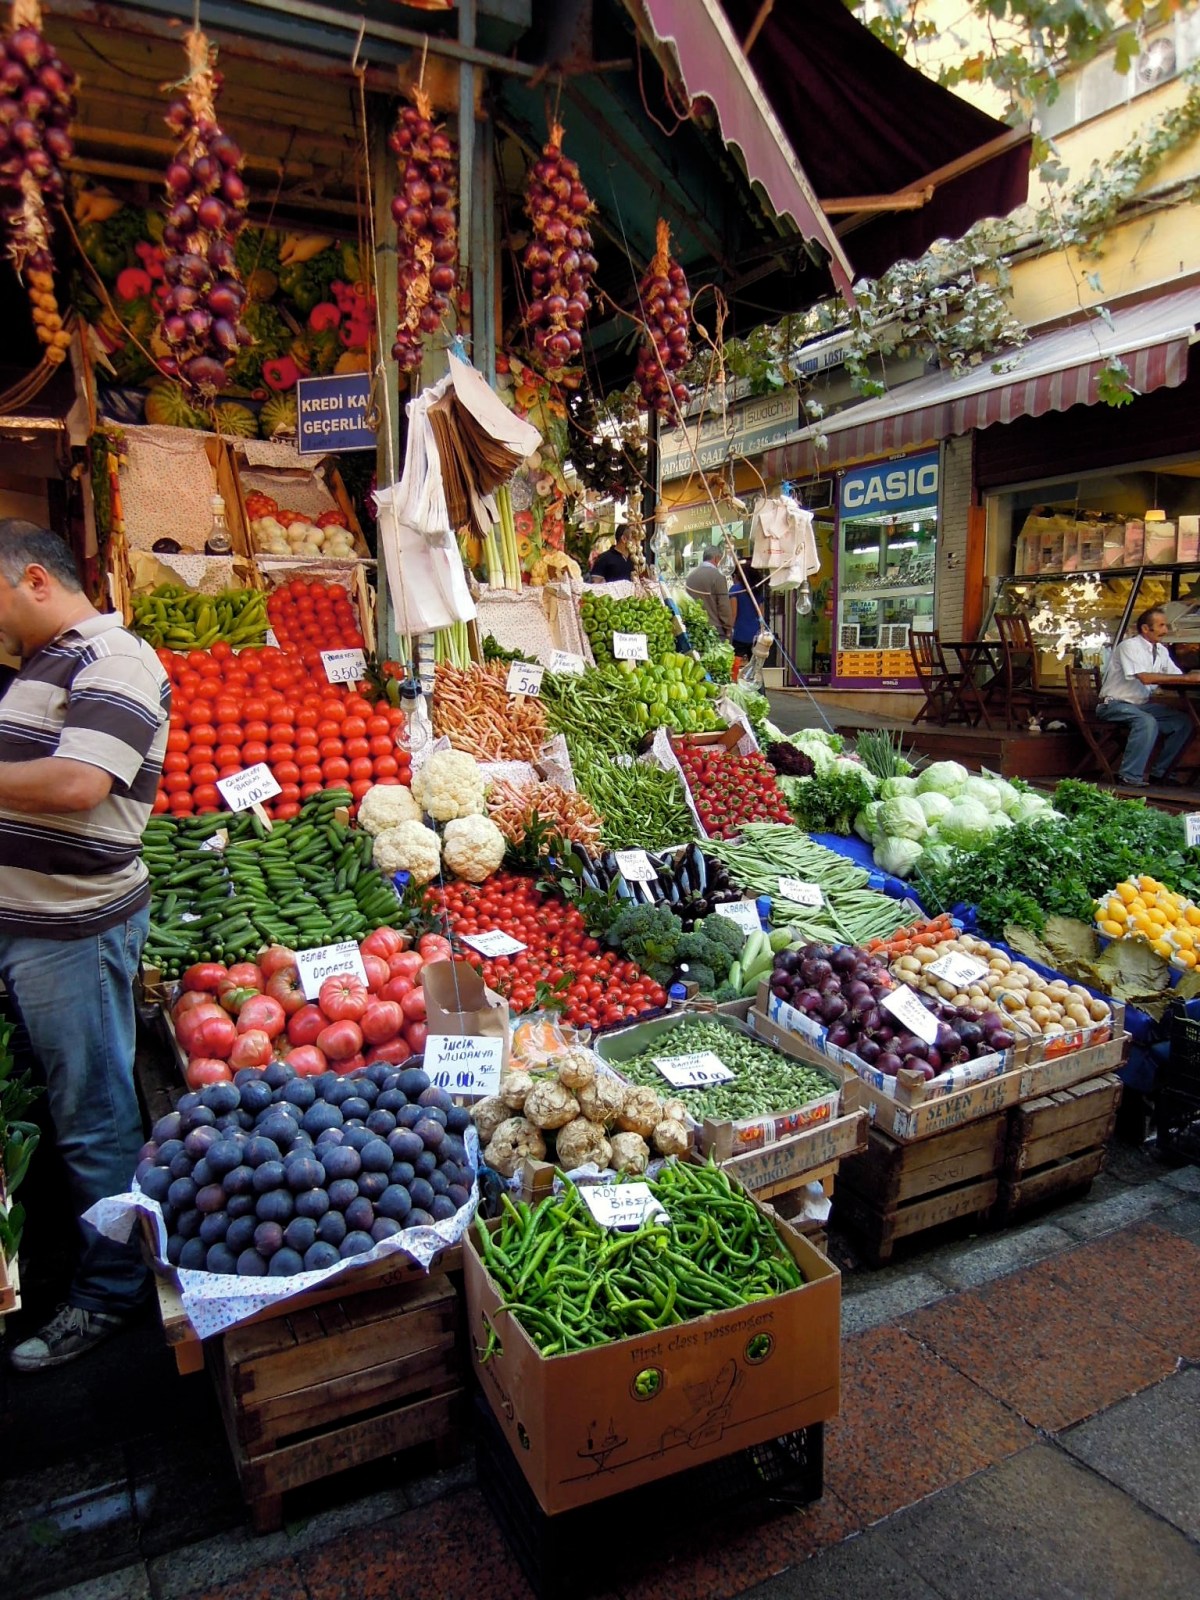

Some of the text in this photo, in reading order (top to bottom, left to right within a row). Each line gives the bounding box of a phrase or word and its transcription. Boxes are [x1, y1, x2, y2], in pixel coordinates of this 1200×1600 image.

[301, 393, 371, 412] KREDİ KA
[746, 401, 784, 424] swatch
[843, 464, 939, 508] CASIO
[723, 903, 751, 914] KABAK
[300, 949, 328, 963] PEMBE
[313, 960, 354, 979] DOMATES
[430, 1071, 475, 1088] 10.00
[926, 1093, 973, 1121] SEVEN
[738, 1145, 795, 1178] SEVEN
[631, 1310, 775, 1363] First class passengers
